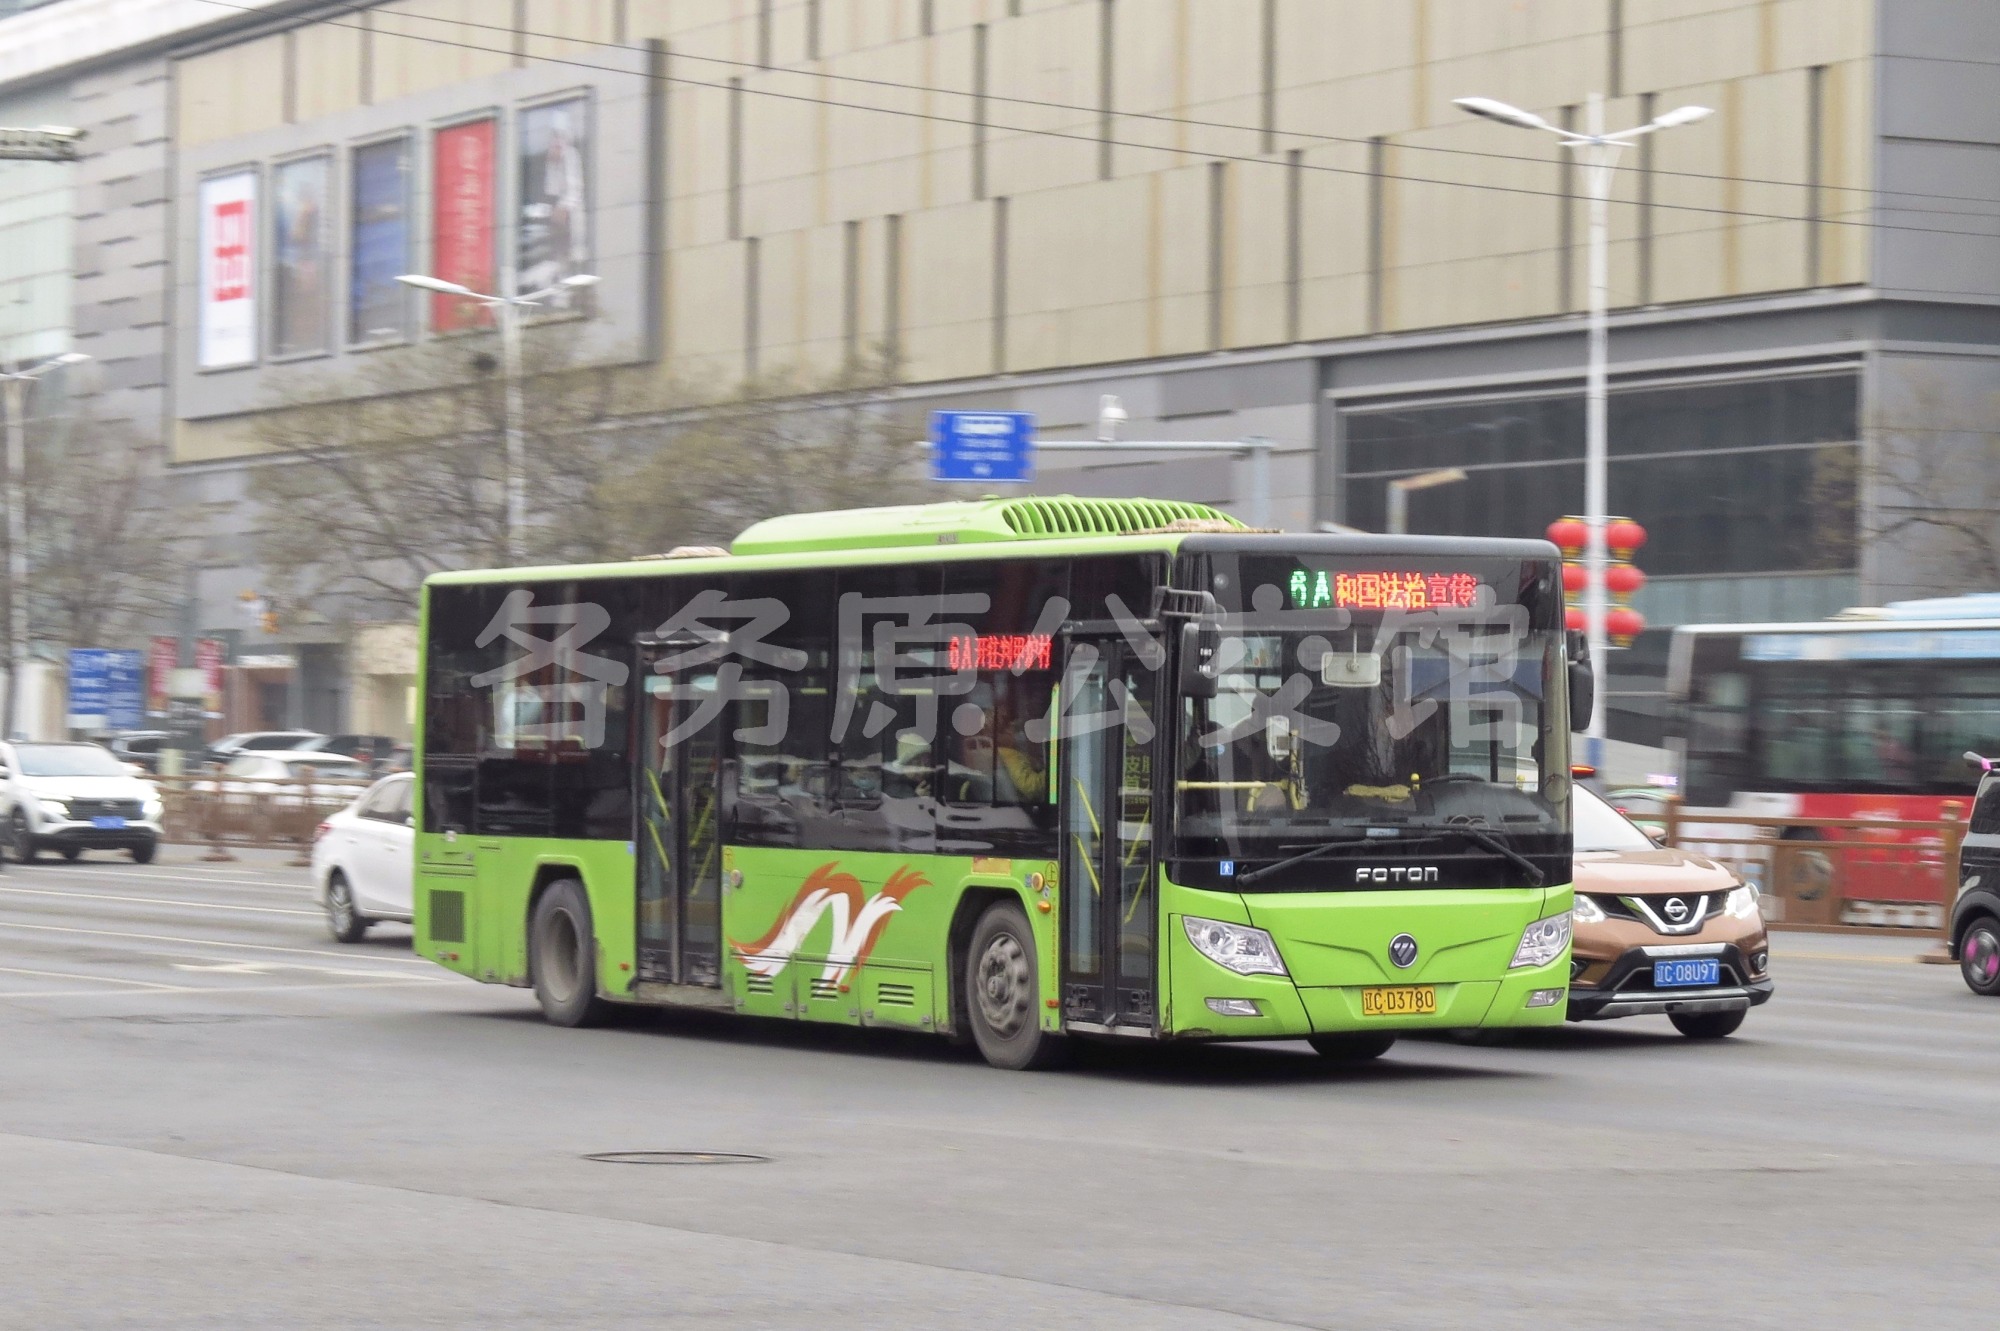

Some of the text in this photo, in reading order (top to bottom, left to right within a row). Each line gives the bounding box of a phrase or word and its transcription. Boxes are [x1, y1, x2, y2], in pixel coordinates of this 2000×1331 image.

[1336, 572, 1477, 609] 和国法治宣传
[1355, 867, 1439, 882] FOTON
